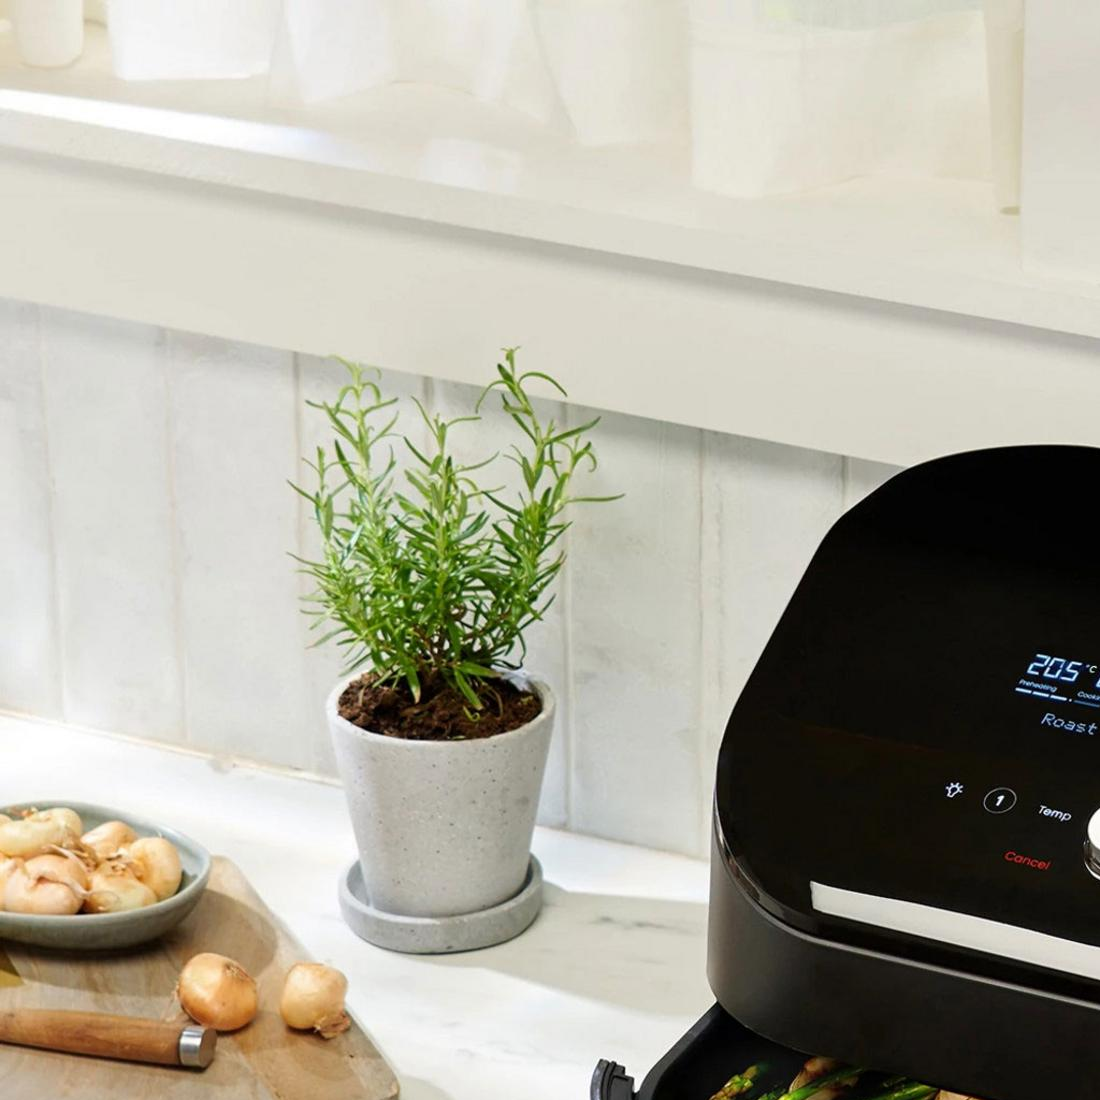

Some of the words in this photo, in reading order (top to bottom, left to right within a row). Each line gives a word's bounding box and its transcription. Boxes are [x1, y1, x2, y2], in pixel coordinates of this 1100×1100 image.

[1018, 678, 1058, 693] Preheating
[1040, 712, 1099, 736] Roast
[995, 795, 1005, 807] 1
[1038, 804, 1072, 822] Temp
[1003, 850, 1052, 871] Cancel
